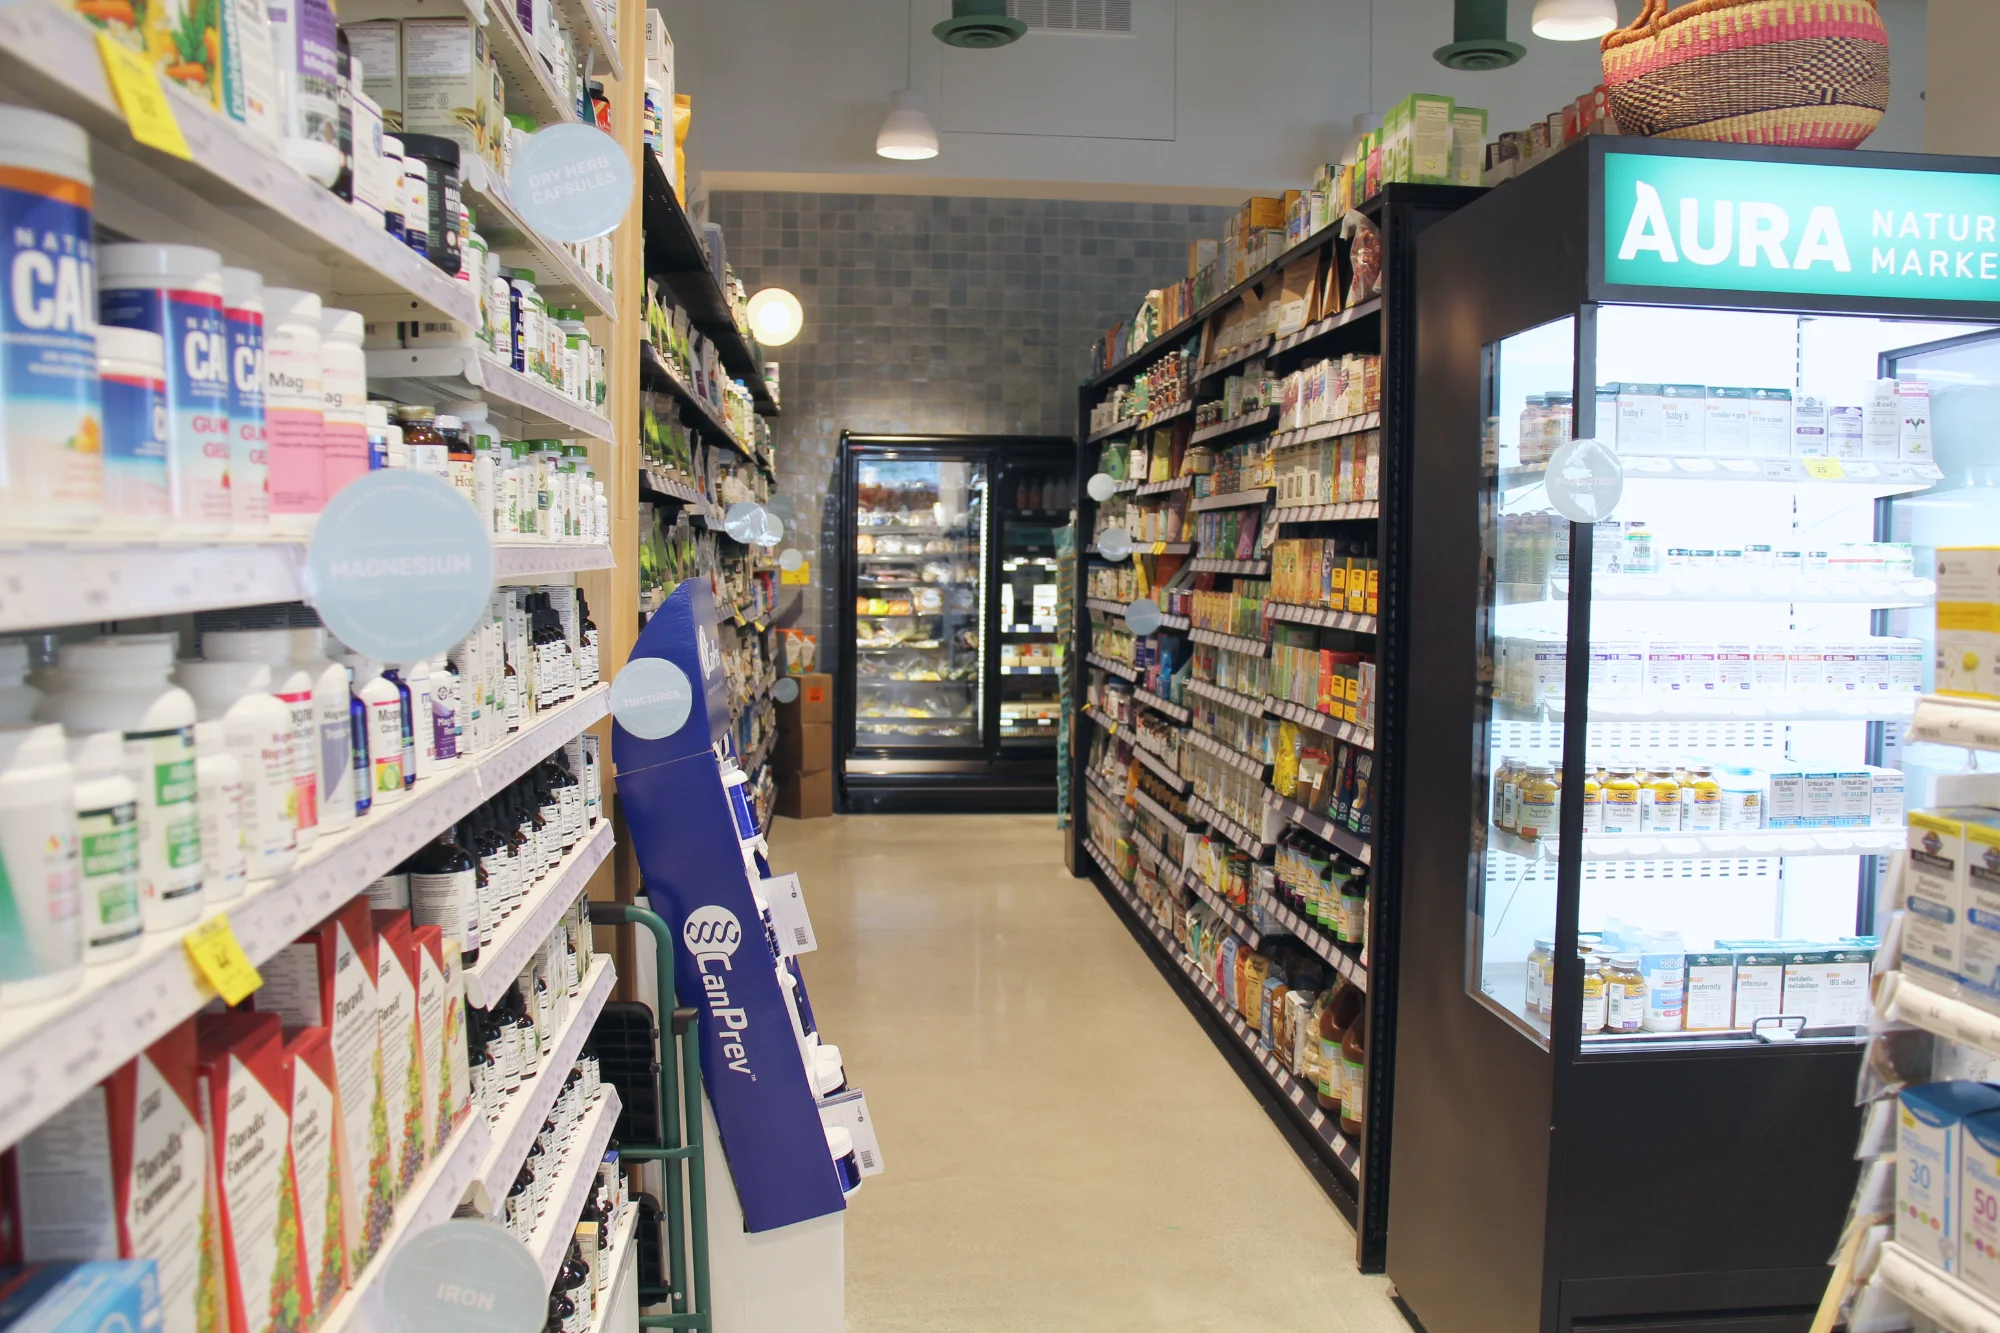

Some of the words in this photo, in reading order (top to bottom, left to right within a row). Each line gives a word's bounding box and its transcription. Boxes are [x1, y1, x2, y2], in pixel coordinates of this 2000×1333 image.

[528, 165, 561, 189] DRY
[563, 153, 611, 178] HERB
[531, 170, 617, 205] CAPSULES
[1618, 179, 1852, 272] AURA
[1872, 209, 1997, 243] NATUR
[1871, 246, 1998, 280] MARKE
[1623, 408, 1638, 419] baby
[1666, 411, 1682, 422] baby
[1684, 411, 1689, 420] b
[1736, 413, 1746, 421] pro
[329, 553, 473, 581] MAGNESIUM
[1693, 983, 1721, 991] maternity
[1741, 979, 1768, 987] intensive
[336, 982, 364, 1022] Floravit
[378, 995, 400, 1021] Floravit
[694, 951, 751, 1075] CanPrev
[229, 1113, 266, 1155] Floradix
[227, 1137, 265, 1181] Formula
[1909, 1158, 1931, 1190] 30
[135, 1164, 182, 1225] Formula
[1973, 1187, 1998, 1223] 50
[436, 1282, 496, 1312] IRON
